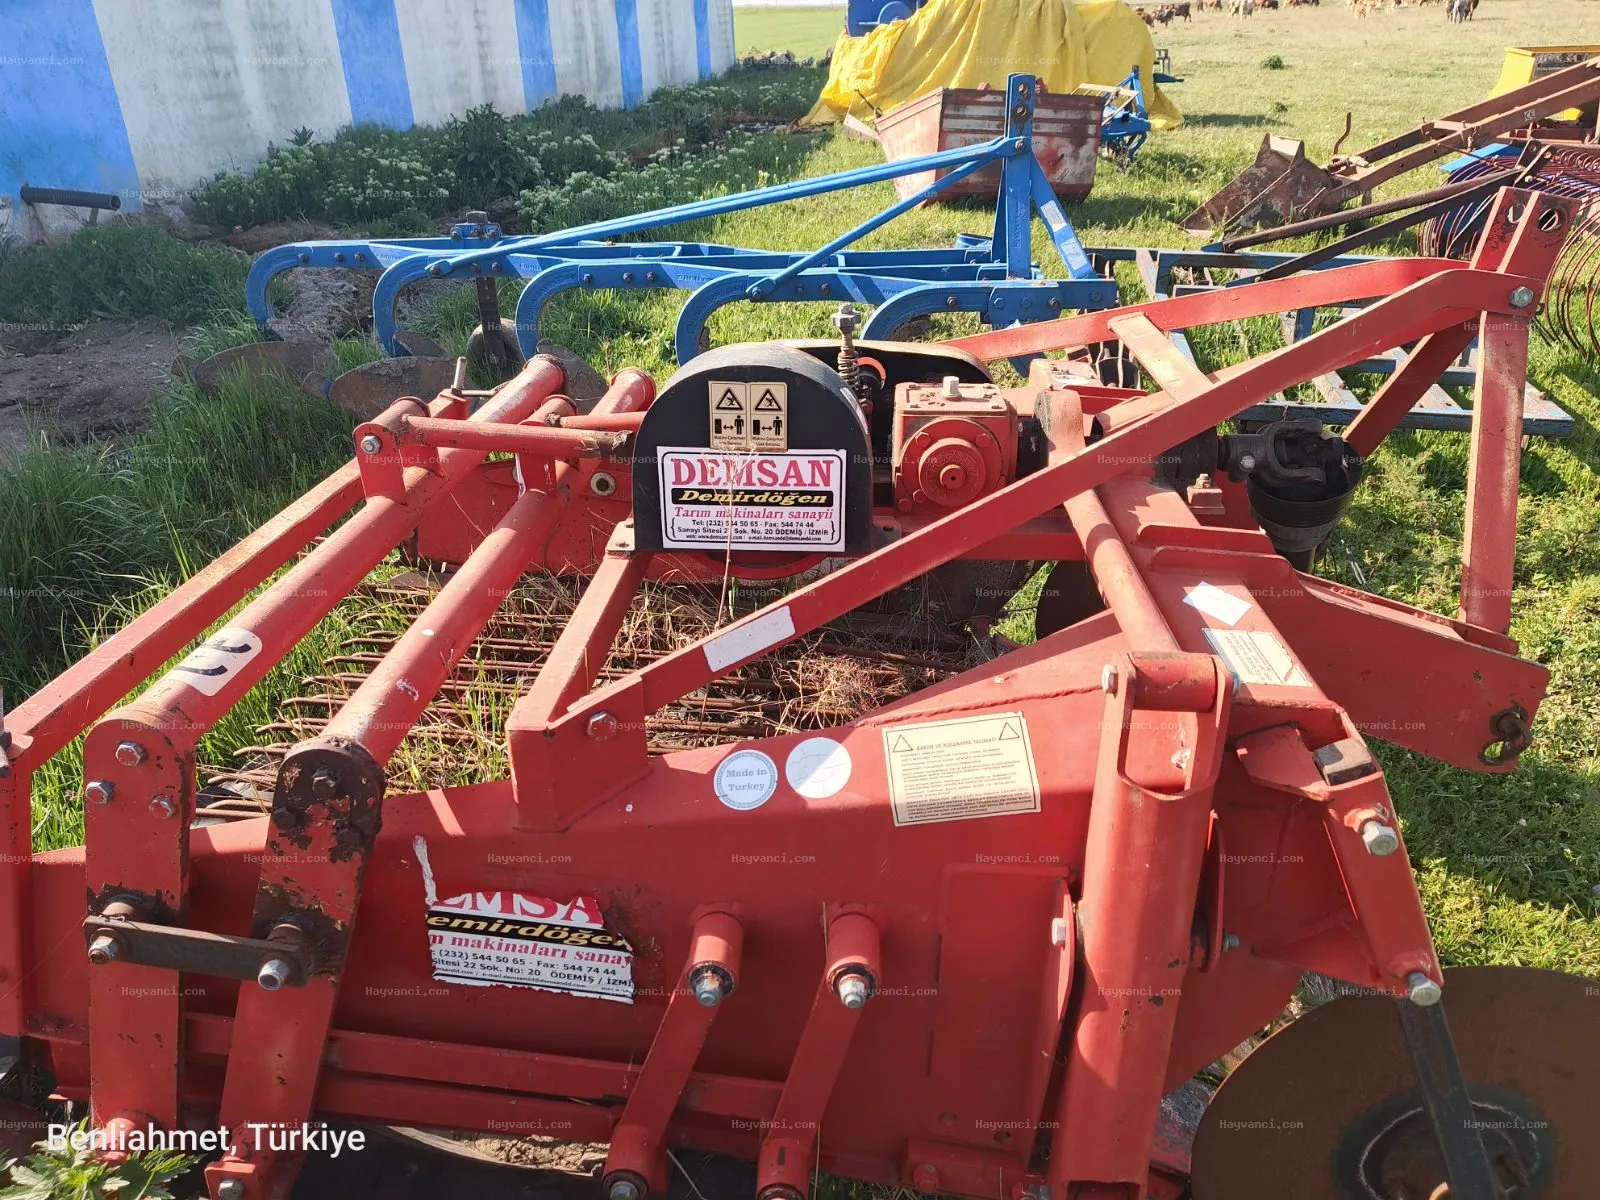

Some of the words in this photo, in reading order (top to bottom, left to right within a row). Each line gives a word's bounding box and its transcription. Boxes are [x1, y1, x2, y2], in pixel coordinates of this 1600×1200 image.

[671, 458, 834, 487] DEMSAN
[679, 490, 828, 505] Demirdöğen
[675, 507, 711, 517] Tarım
[788, 509, 834, 521] sanayii
[726, 769, 754, 778] Made
[757, 768, 767, 776] in
[728, 782, 765, 792] Turkey
[451, 936, 568, 959] makinaları
[439, 949, 468, 960] (232)
[537, 961, 559, 969] Fax:
[563, 964, 583, 972] 544
[550, 970, 594, 984] ÖDEMİŞ
